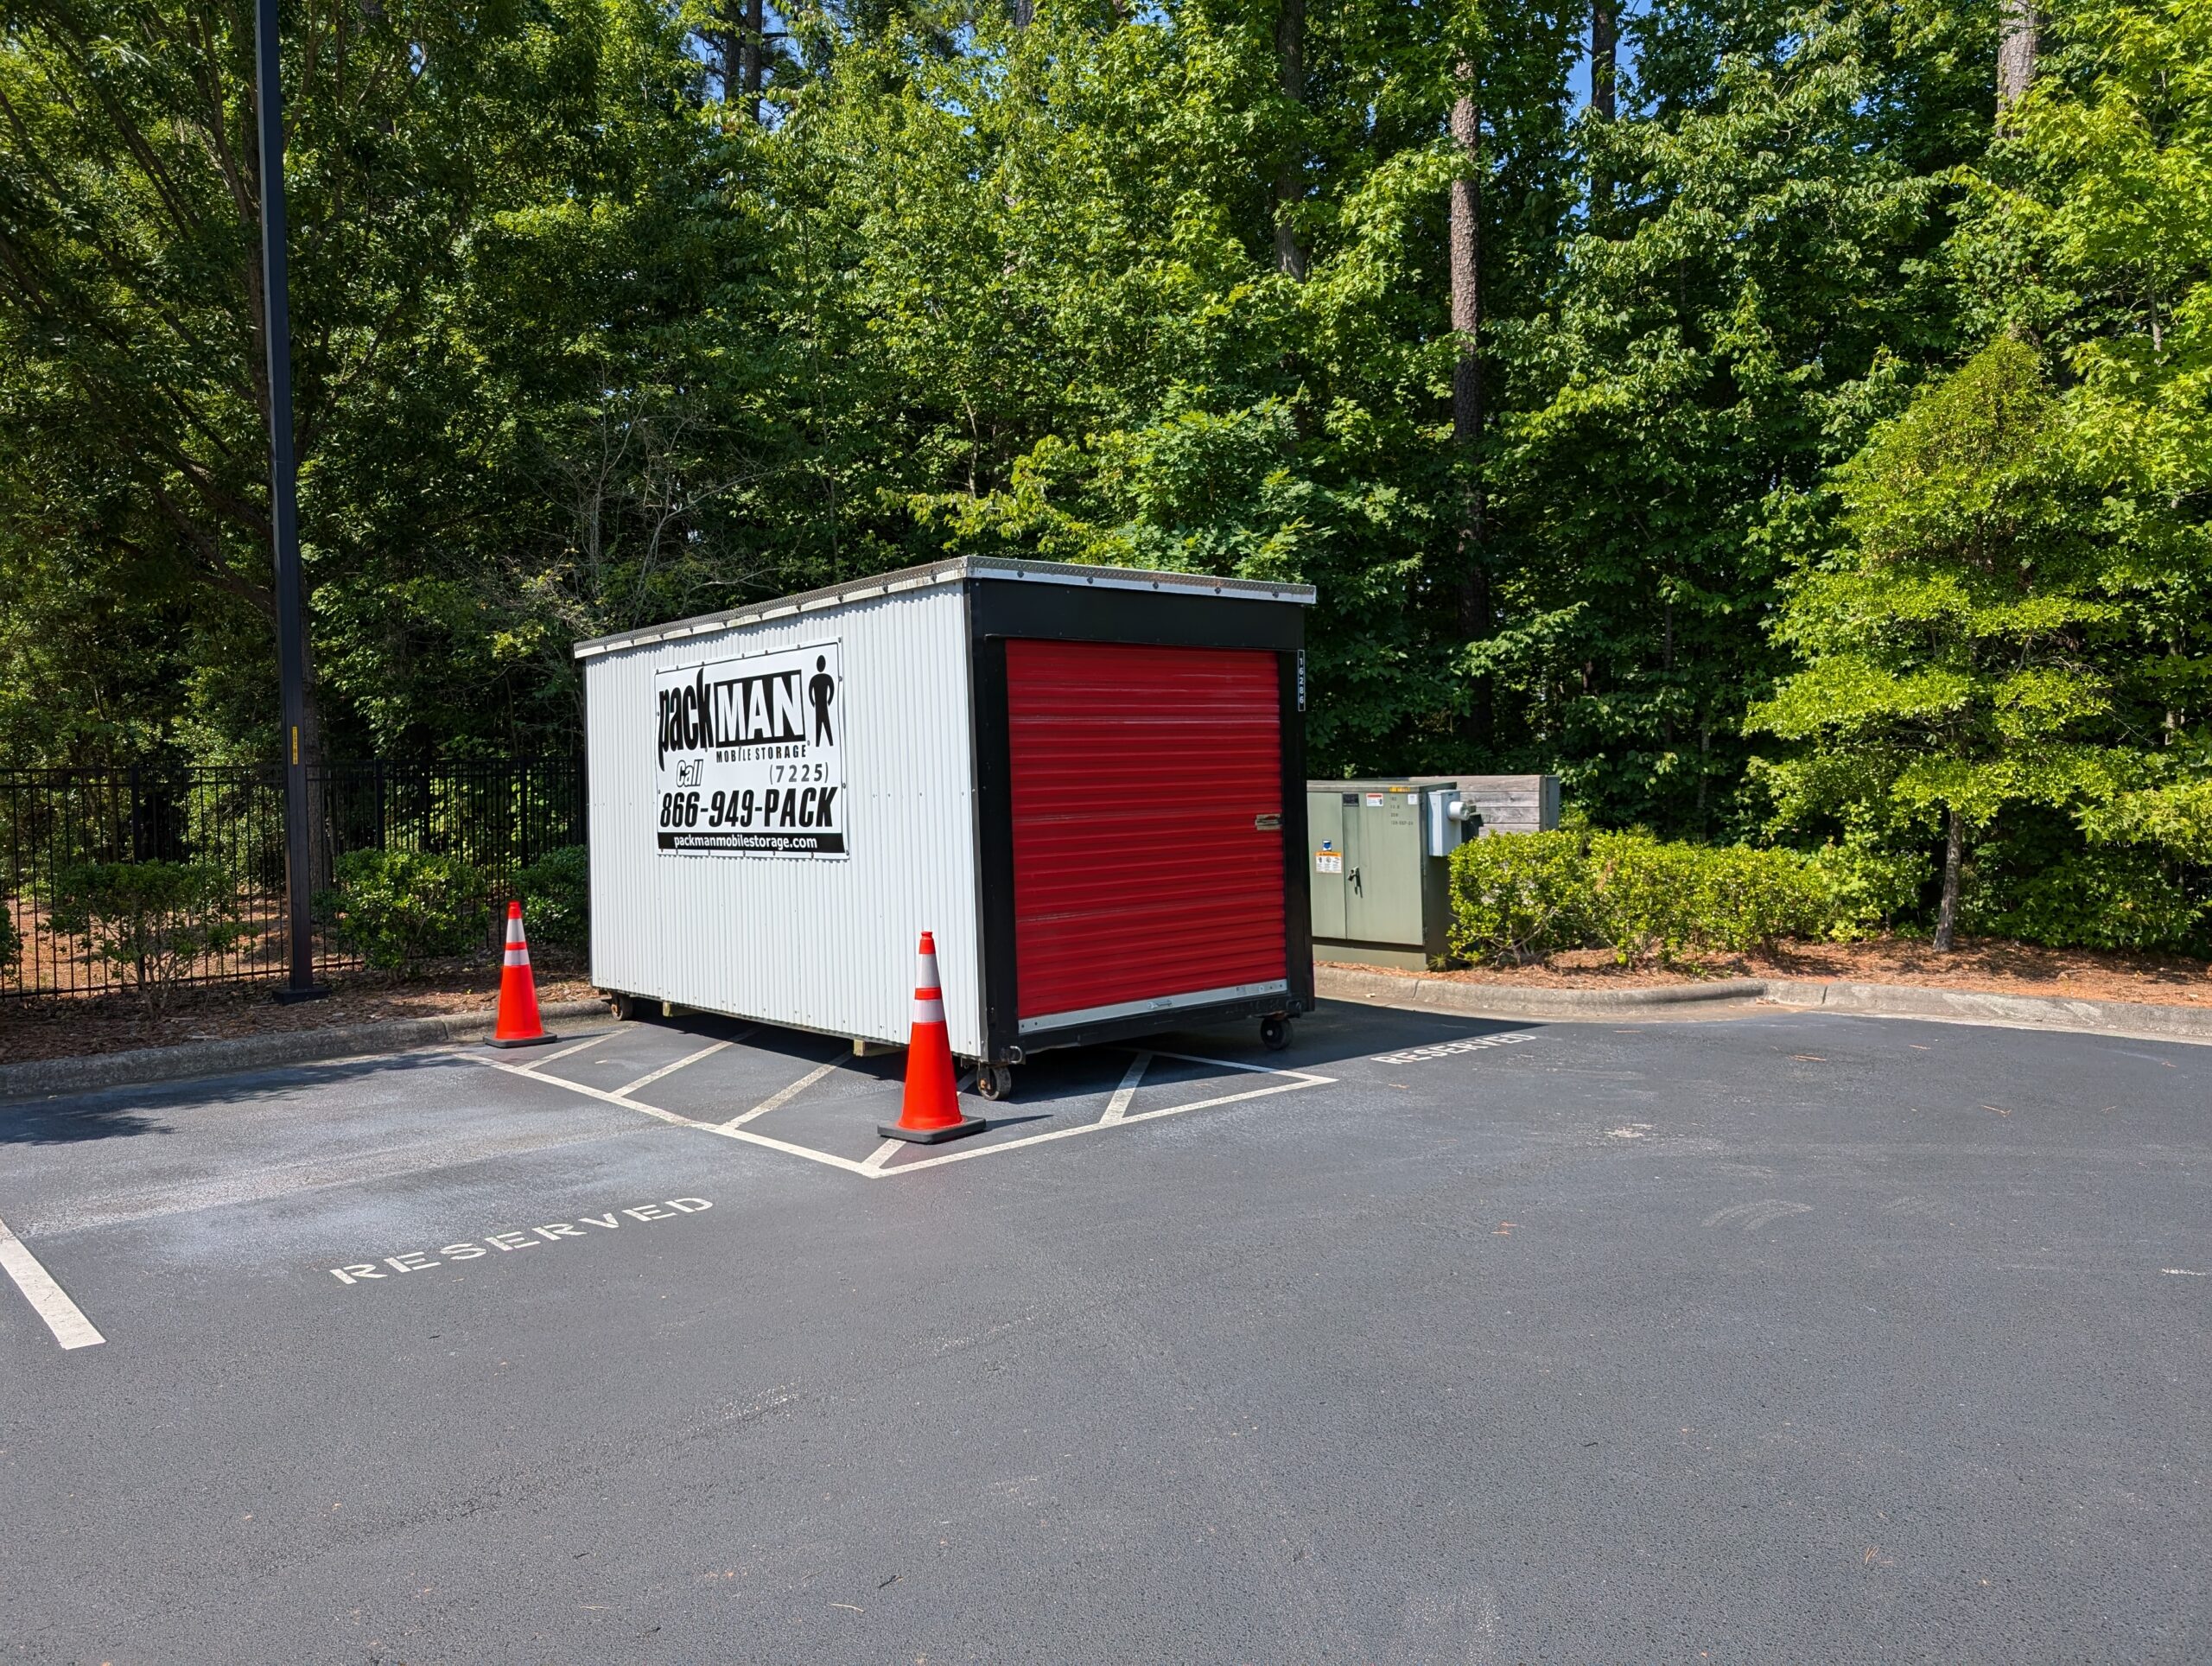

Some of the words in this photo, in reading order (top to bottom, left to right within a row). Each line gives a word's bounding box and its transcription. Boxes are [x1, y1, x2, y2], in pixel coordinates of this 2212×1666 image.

[716, 746, 751, 763] MOBILE
[755, 745, 806, 760] STORAGE
[677, 760, 703, 787] Call
[770, 762, 829, 785] (7225)
[660, 787, 838, 828] 866-949-PACK
[674, 834, 817, 850] packmanmobilestorage.com
[1370, 1033, 1537, 1065] RESERVED
[330, 1198, 714, 1285] RESERVED
